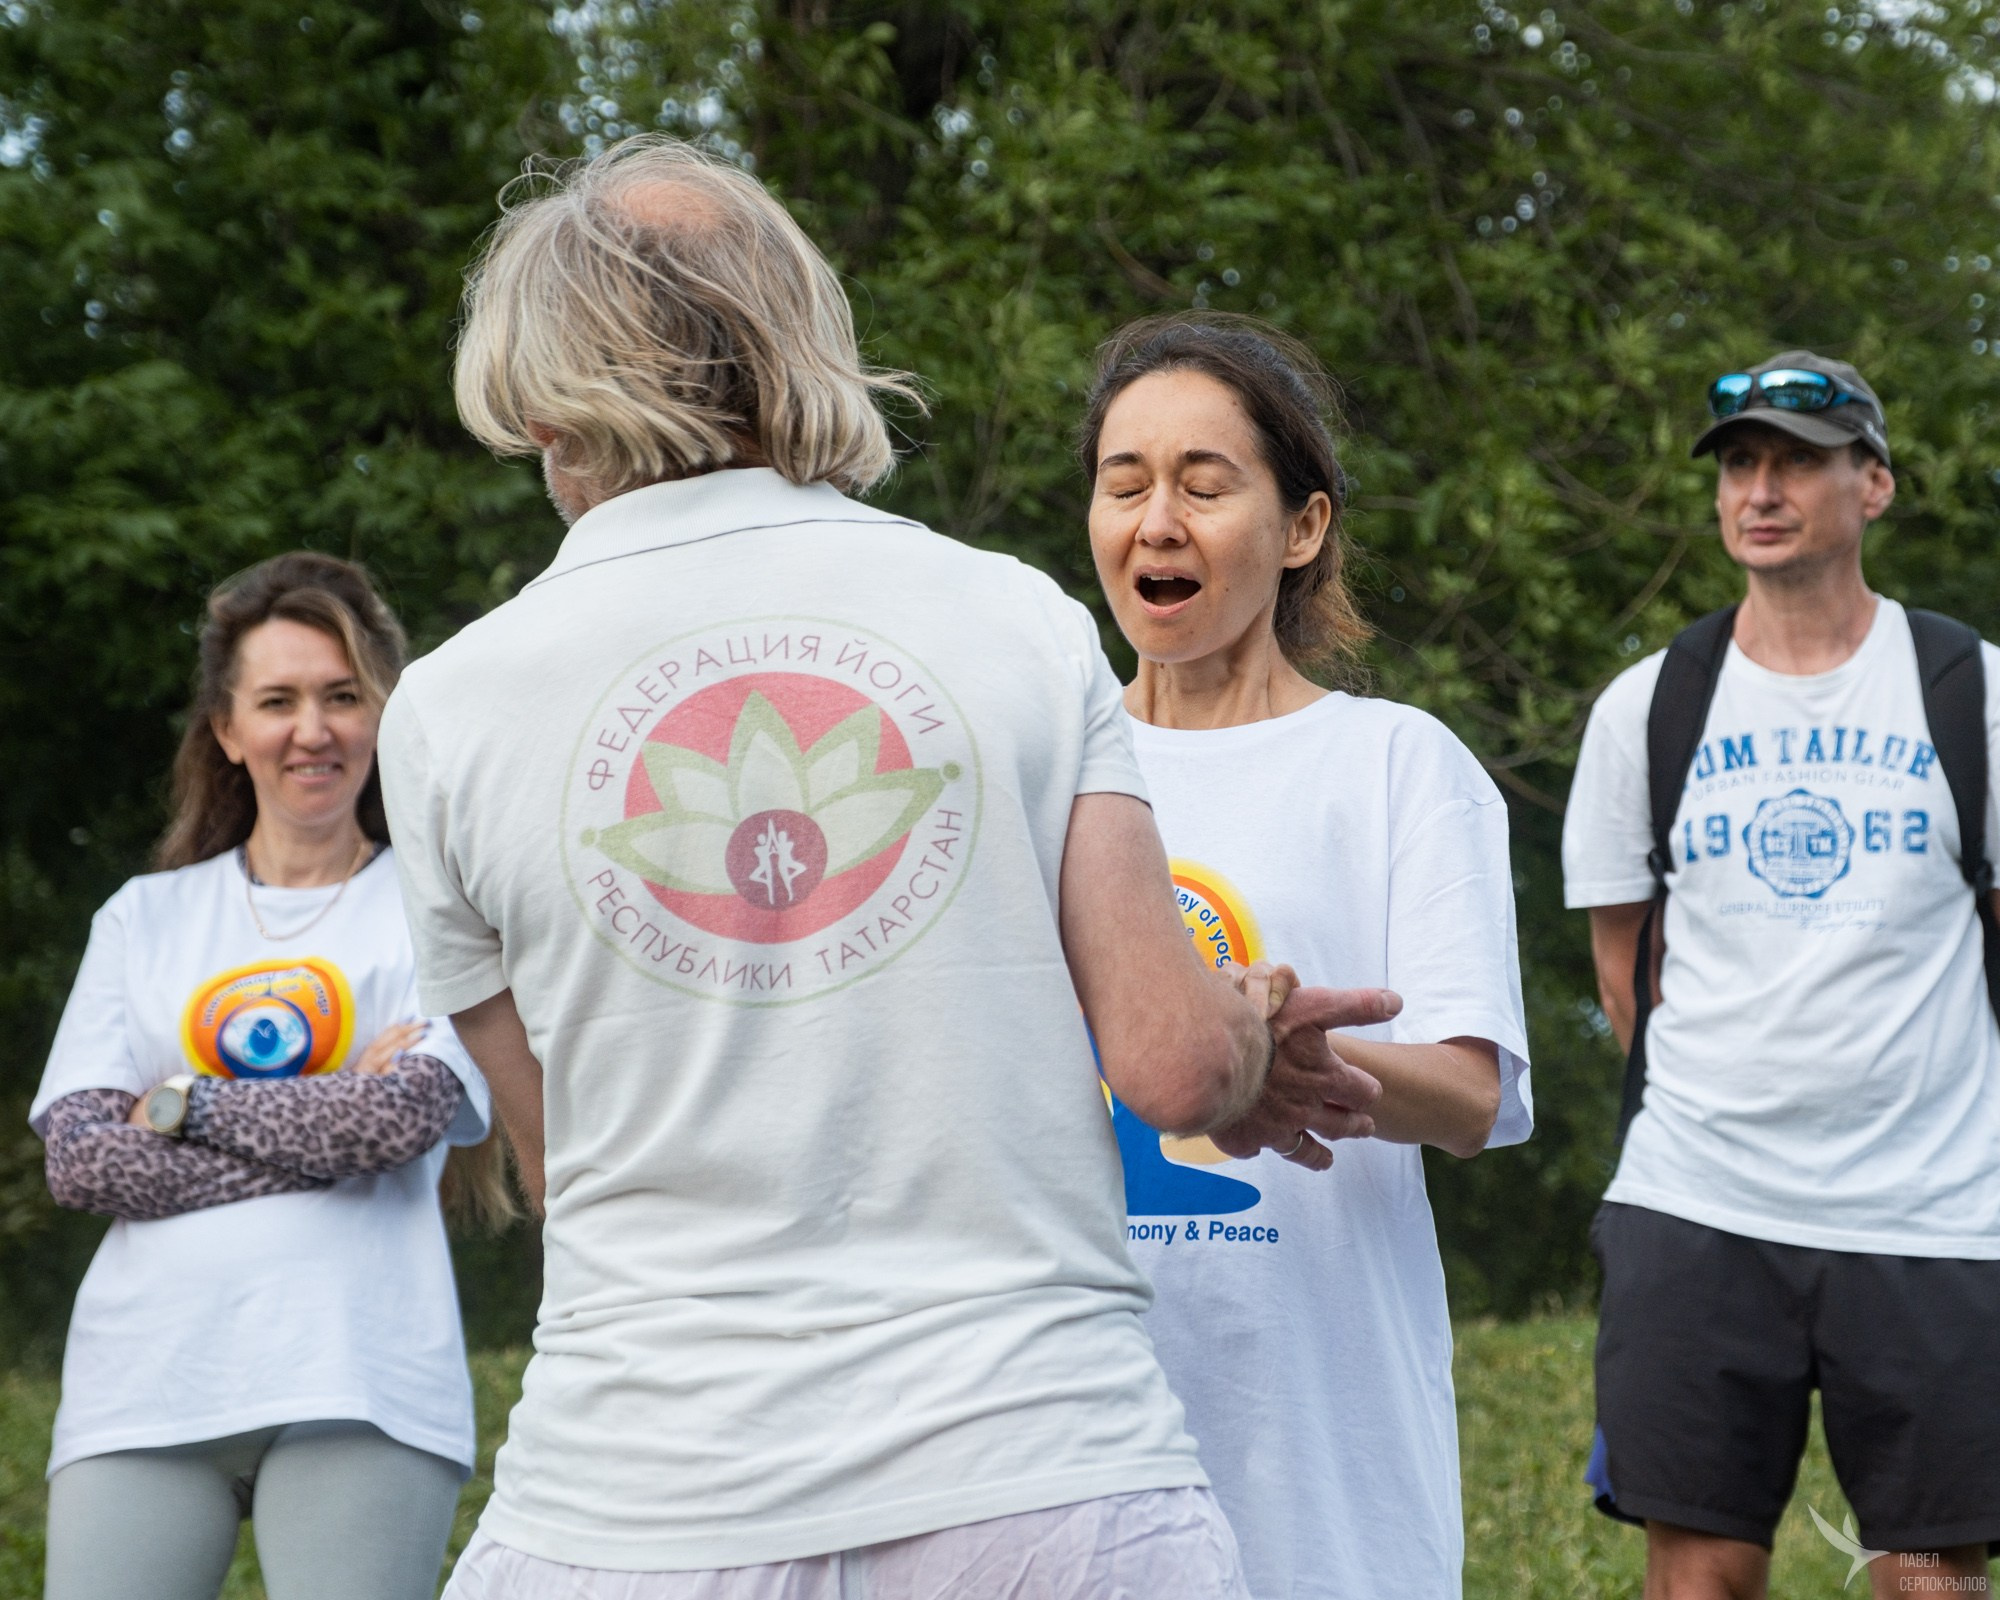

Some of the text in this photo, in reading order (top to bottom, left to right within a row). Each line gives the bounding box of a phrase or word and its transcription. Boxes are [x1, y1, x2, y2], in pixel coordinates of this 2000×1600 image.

[587, 633, 945, 791] ФЕДЕРАЦИЯ ЙОГИ
[1694, 726, 1938, 780] OM TAILOR
[1684, 813, 1731, 863] 19
[1863, 808, 1930, 855] 62
[587, 809, 963, 991] РЕСПУБЛИКИ ТАТАРСТАН
[1175, 888, 1232, 968] ay of yog
[1126, 1221, 1279, 1245] mony & Peace
